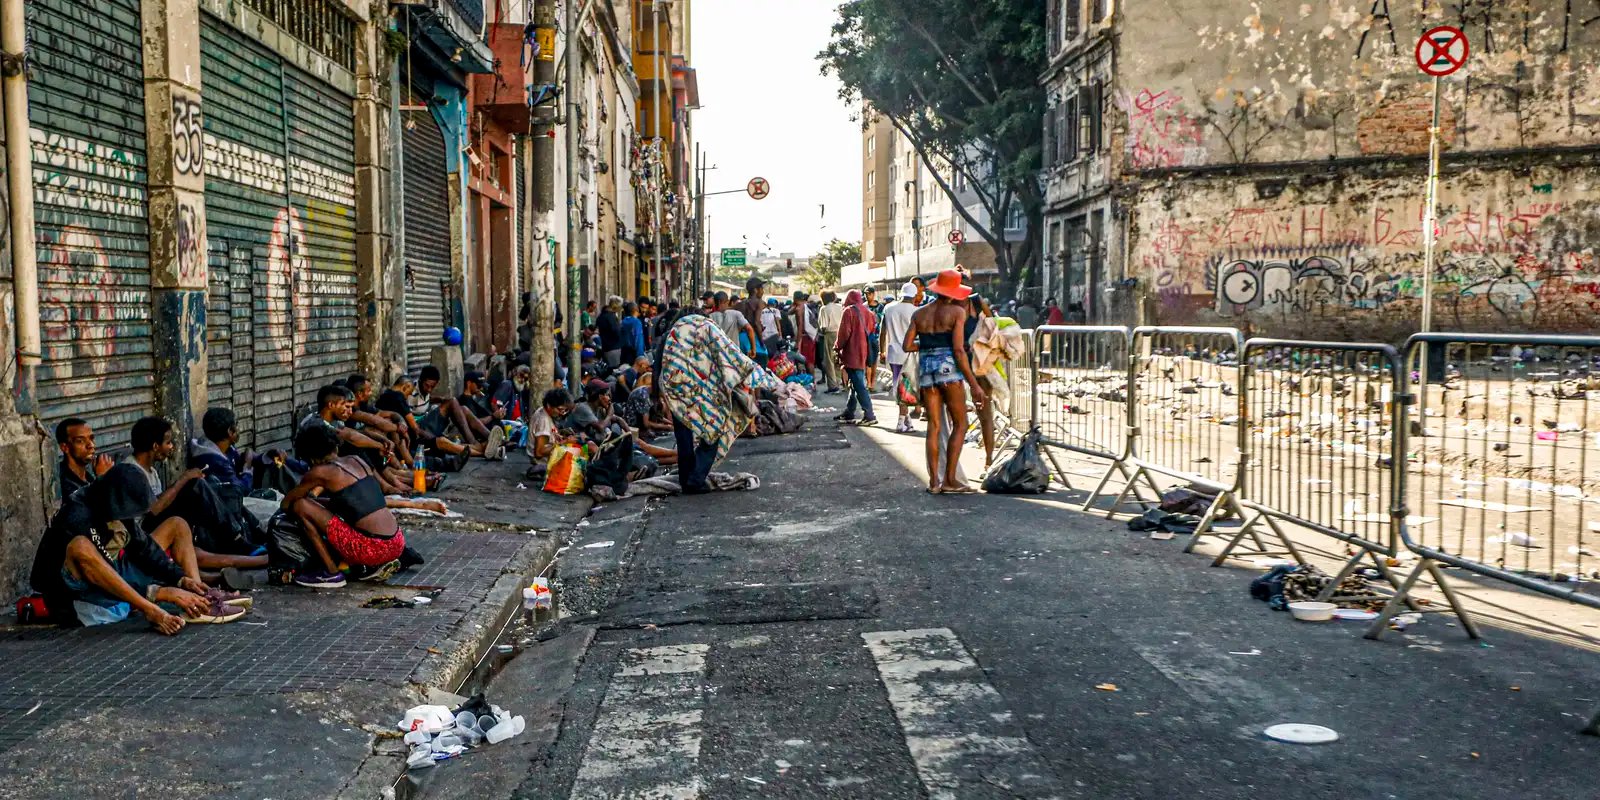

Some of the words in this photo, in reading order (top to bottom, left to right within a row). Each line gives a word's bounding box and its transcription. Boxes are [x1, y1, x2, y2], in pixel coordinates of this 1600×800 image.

[173, 94, 203, 175] 35
[202, 133, 287, 194] ROIBIDO
[33, 168, 144, 217] TACIONAR
